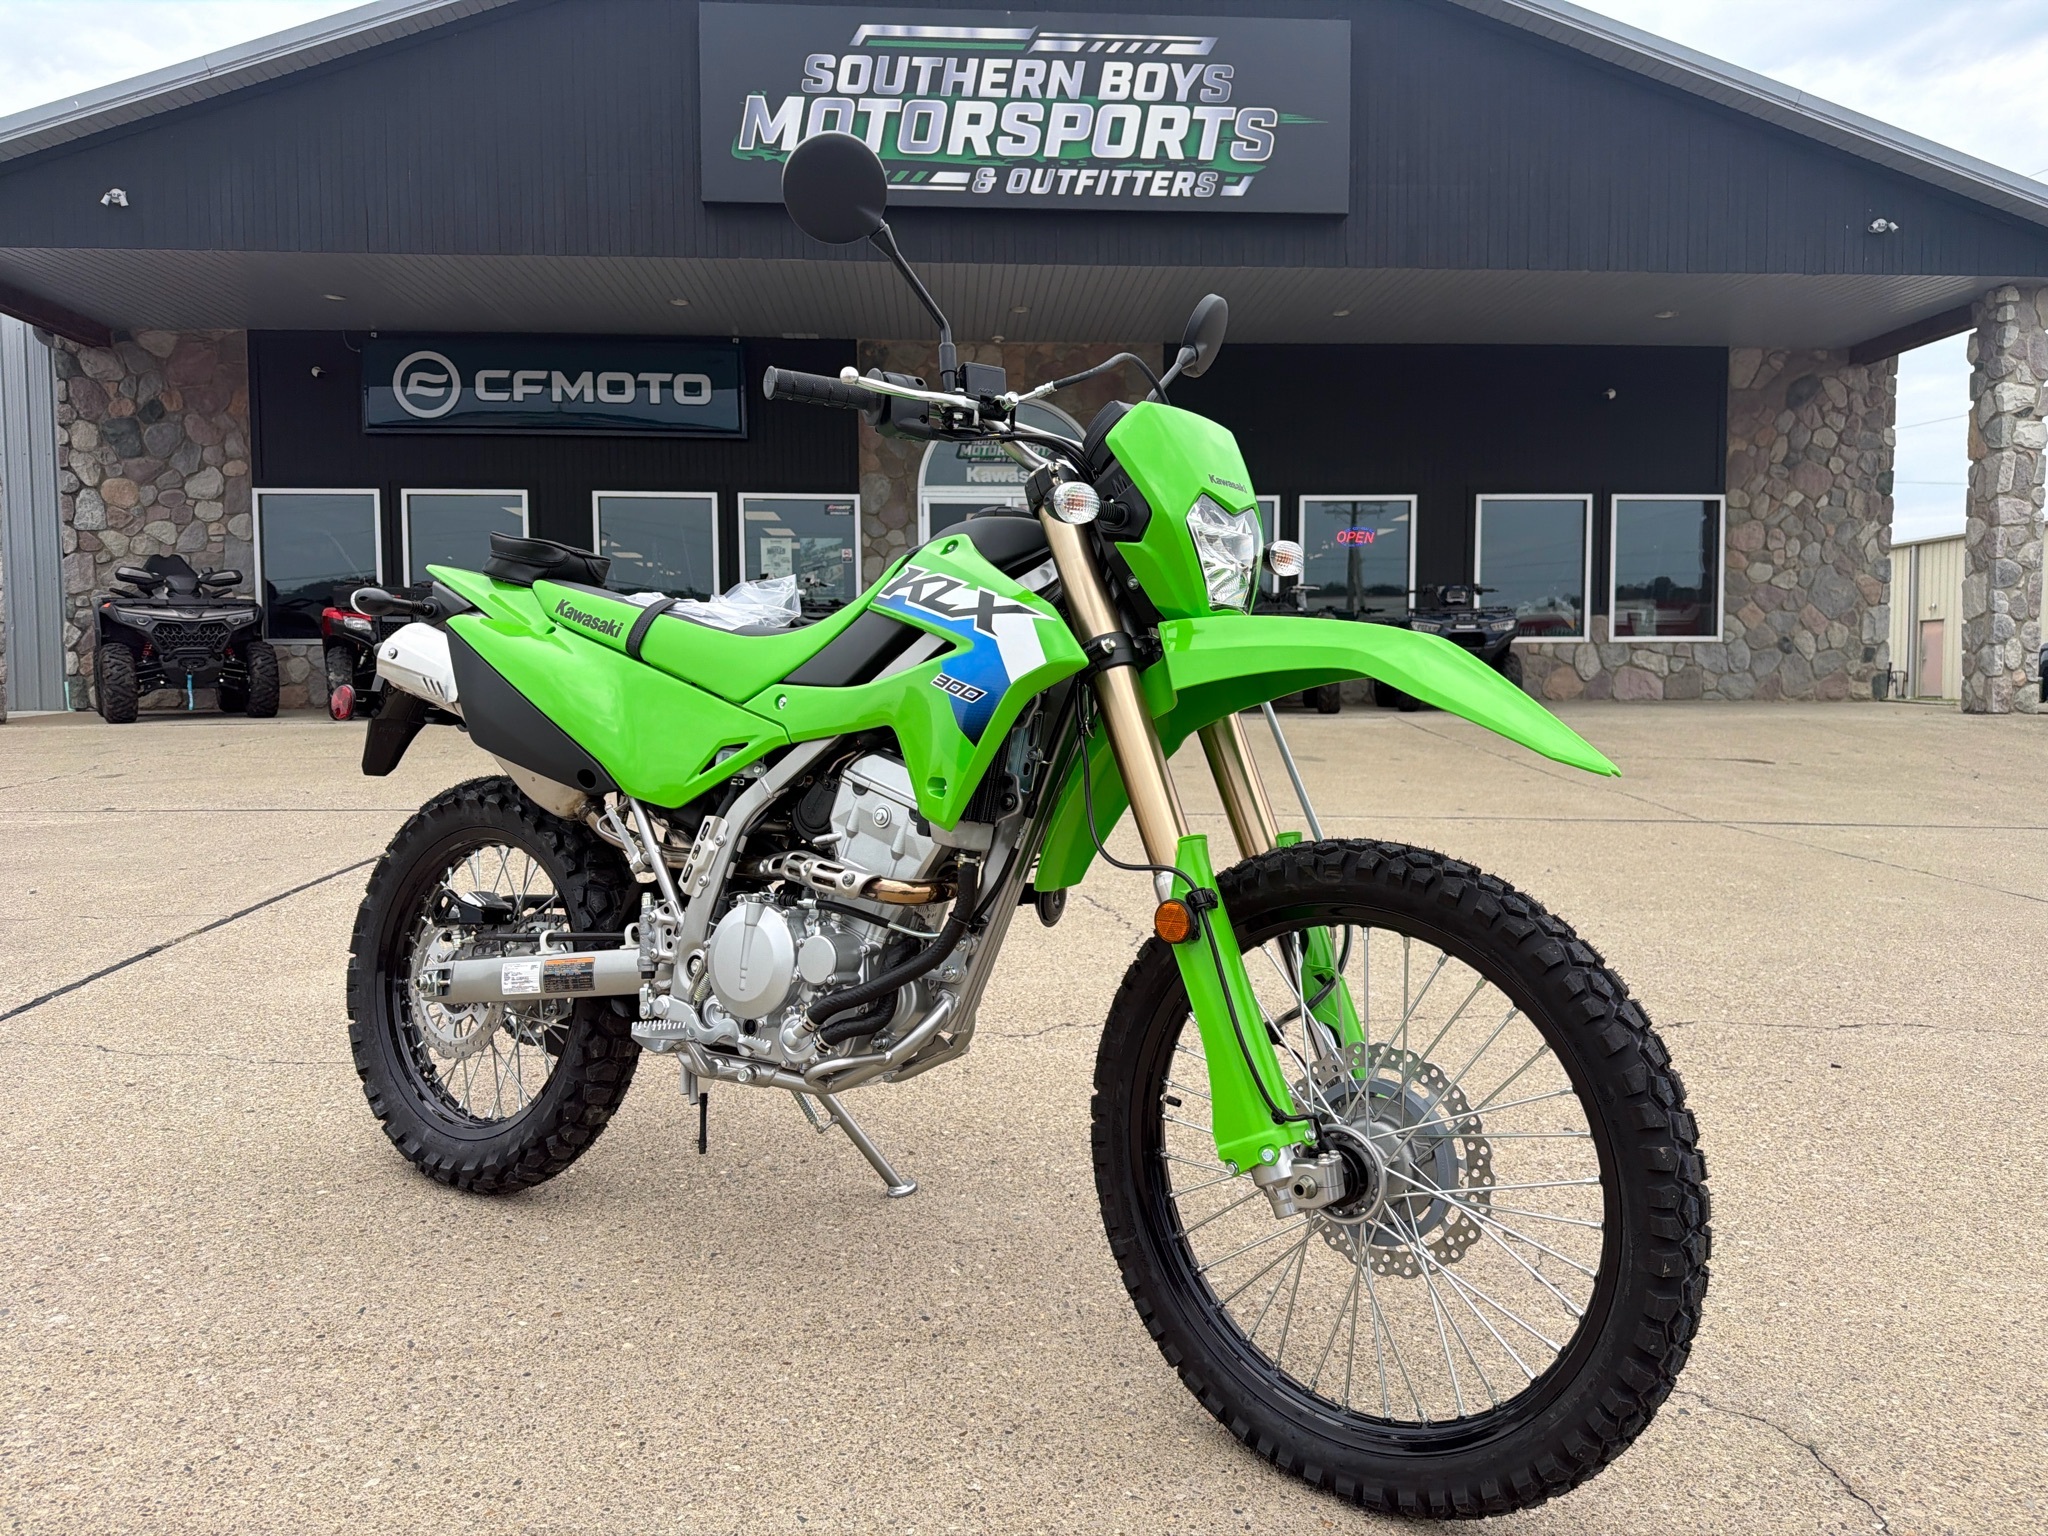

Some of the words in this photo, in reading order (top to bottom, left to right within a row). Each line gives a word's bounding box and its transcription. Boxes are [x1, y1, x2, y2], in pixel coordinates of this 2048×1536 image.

[801, 54, 1086, 99] SOUTHERN
[1098, 61, 1234, 103] BOYS
[738, 95, 1278, 162] MOTORSPORTS
[972, 167, 997, 194] &
[1006, 168, 1218, 197] OUTFITTERS
[474, 369, 713, 405] CFMOTO
[1207, 473, 1248, 494] Kawasaki
[1336, 530, 1375, 544] OPEN
[554, 599, 624, 638] Kawasaki
[879, 565, 1048, 638] KLX
[931, 673, 988, 702] 300
